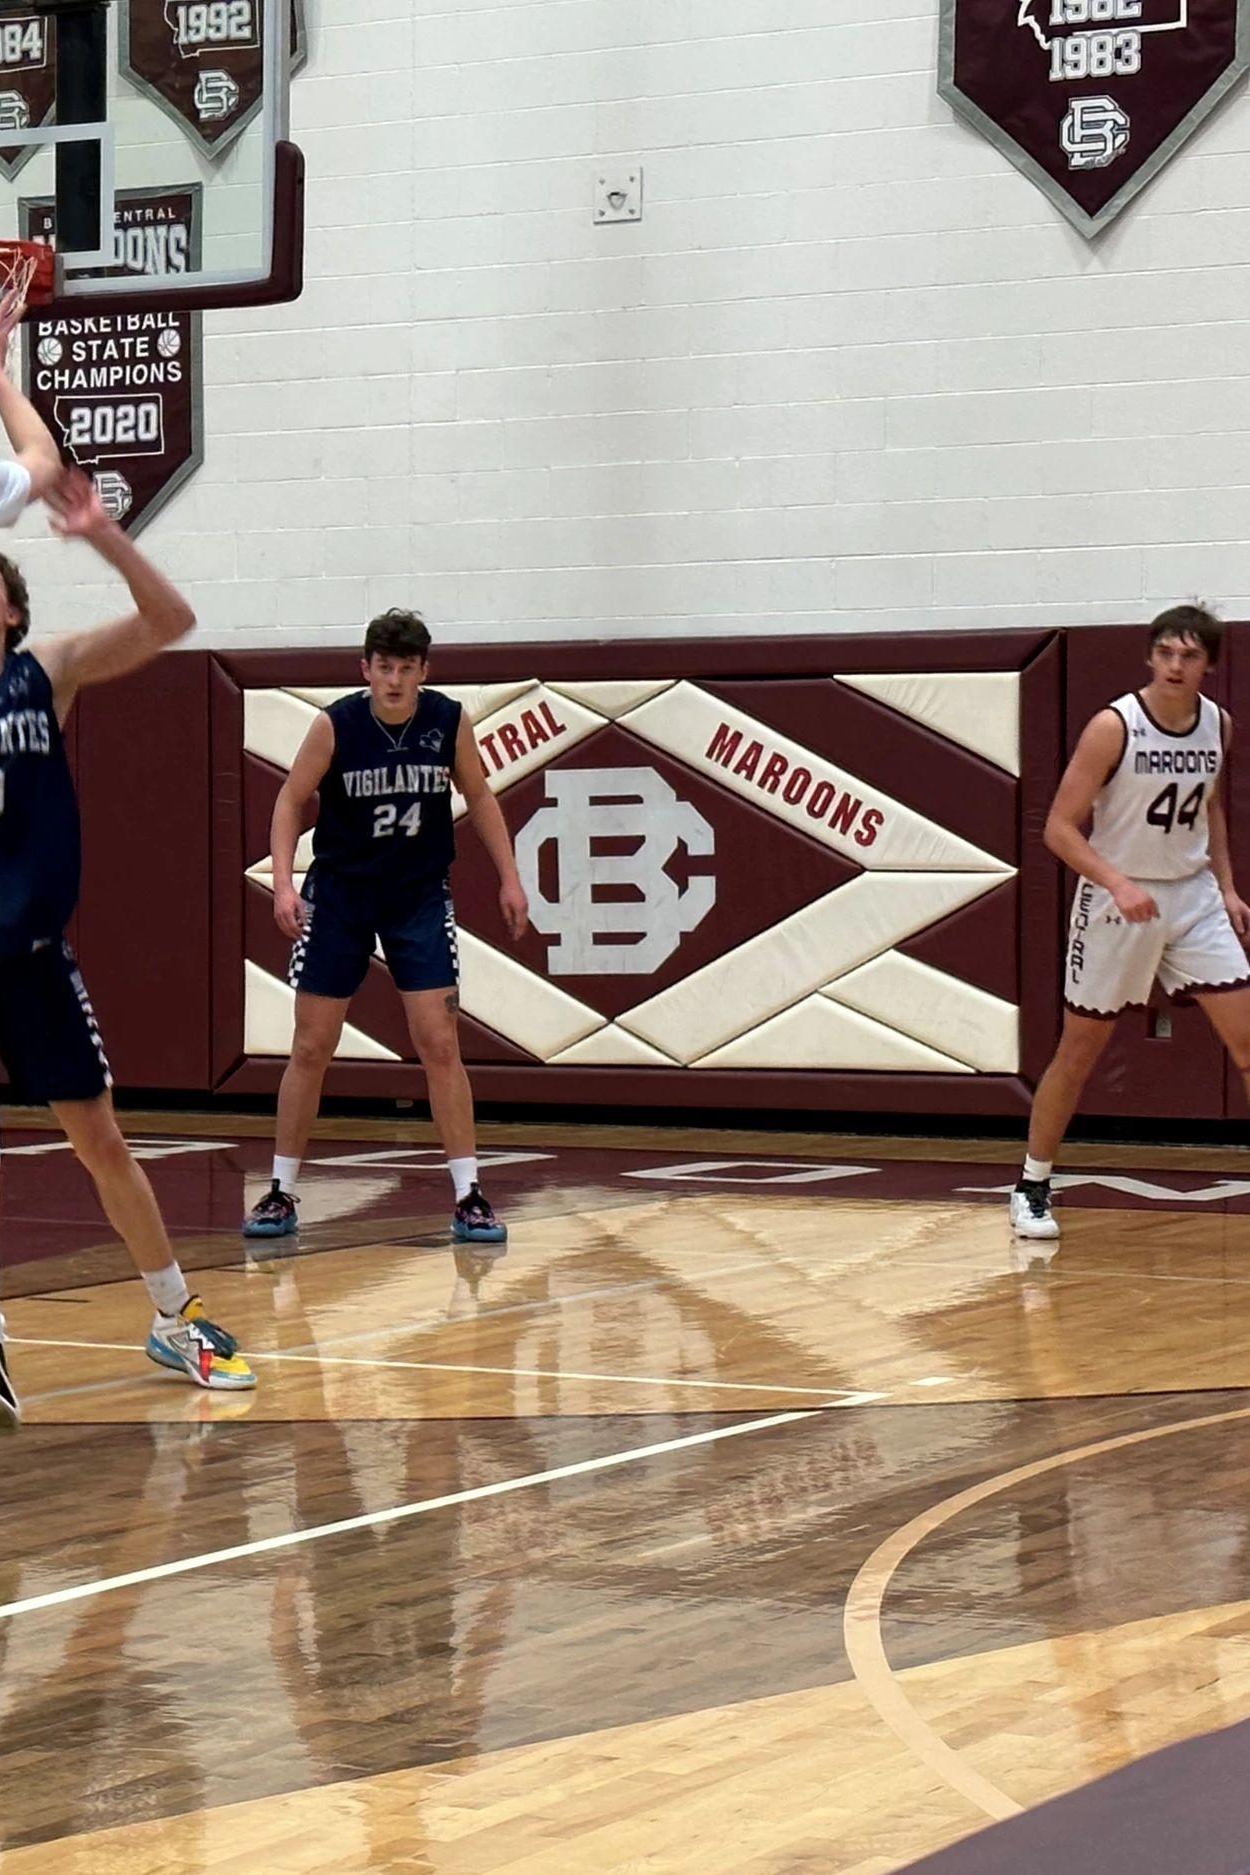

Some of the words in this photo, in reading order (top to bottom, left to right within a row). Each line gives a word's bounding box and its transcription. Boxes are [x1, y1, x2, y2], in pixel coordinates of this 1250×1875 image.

[176, 0, 252, 45] 1992
[1049, 29, 1142, 81] 1983
[114, 206, 177, 223] ENTRAL
[38, 311, 181, 337] BASKETBALL
[72, 336, 150, 362] STATE
[36, 361, 182, 390] CHAMPIONS
[69, 402, 160, 445] 2020
[478, 701, 567, 779] TRAL
[1135, 749, 1218, 774] MAROONS
[342, 764, 450, 798] VIGILANTES
[705, 722, 885, 847] MAROONS
[372, 802, 421, 838] 24
[1146, 781, 1205, 835] 44
